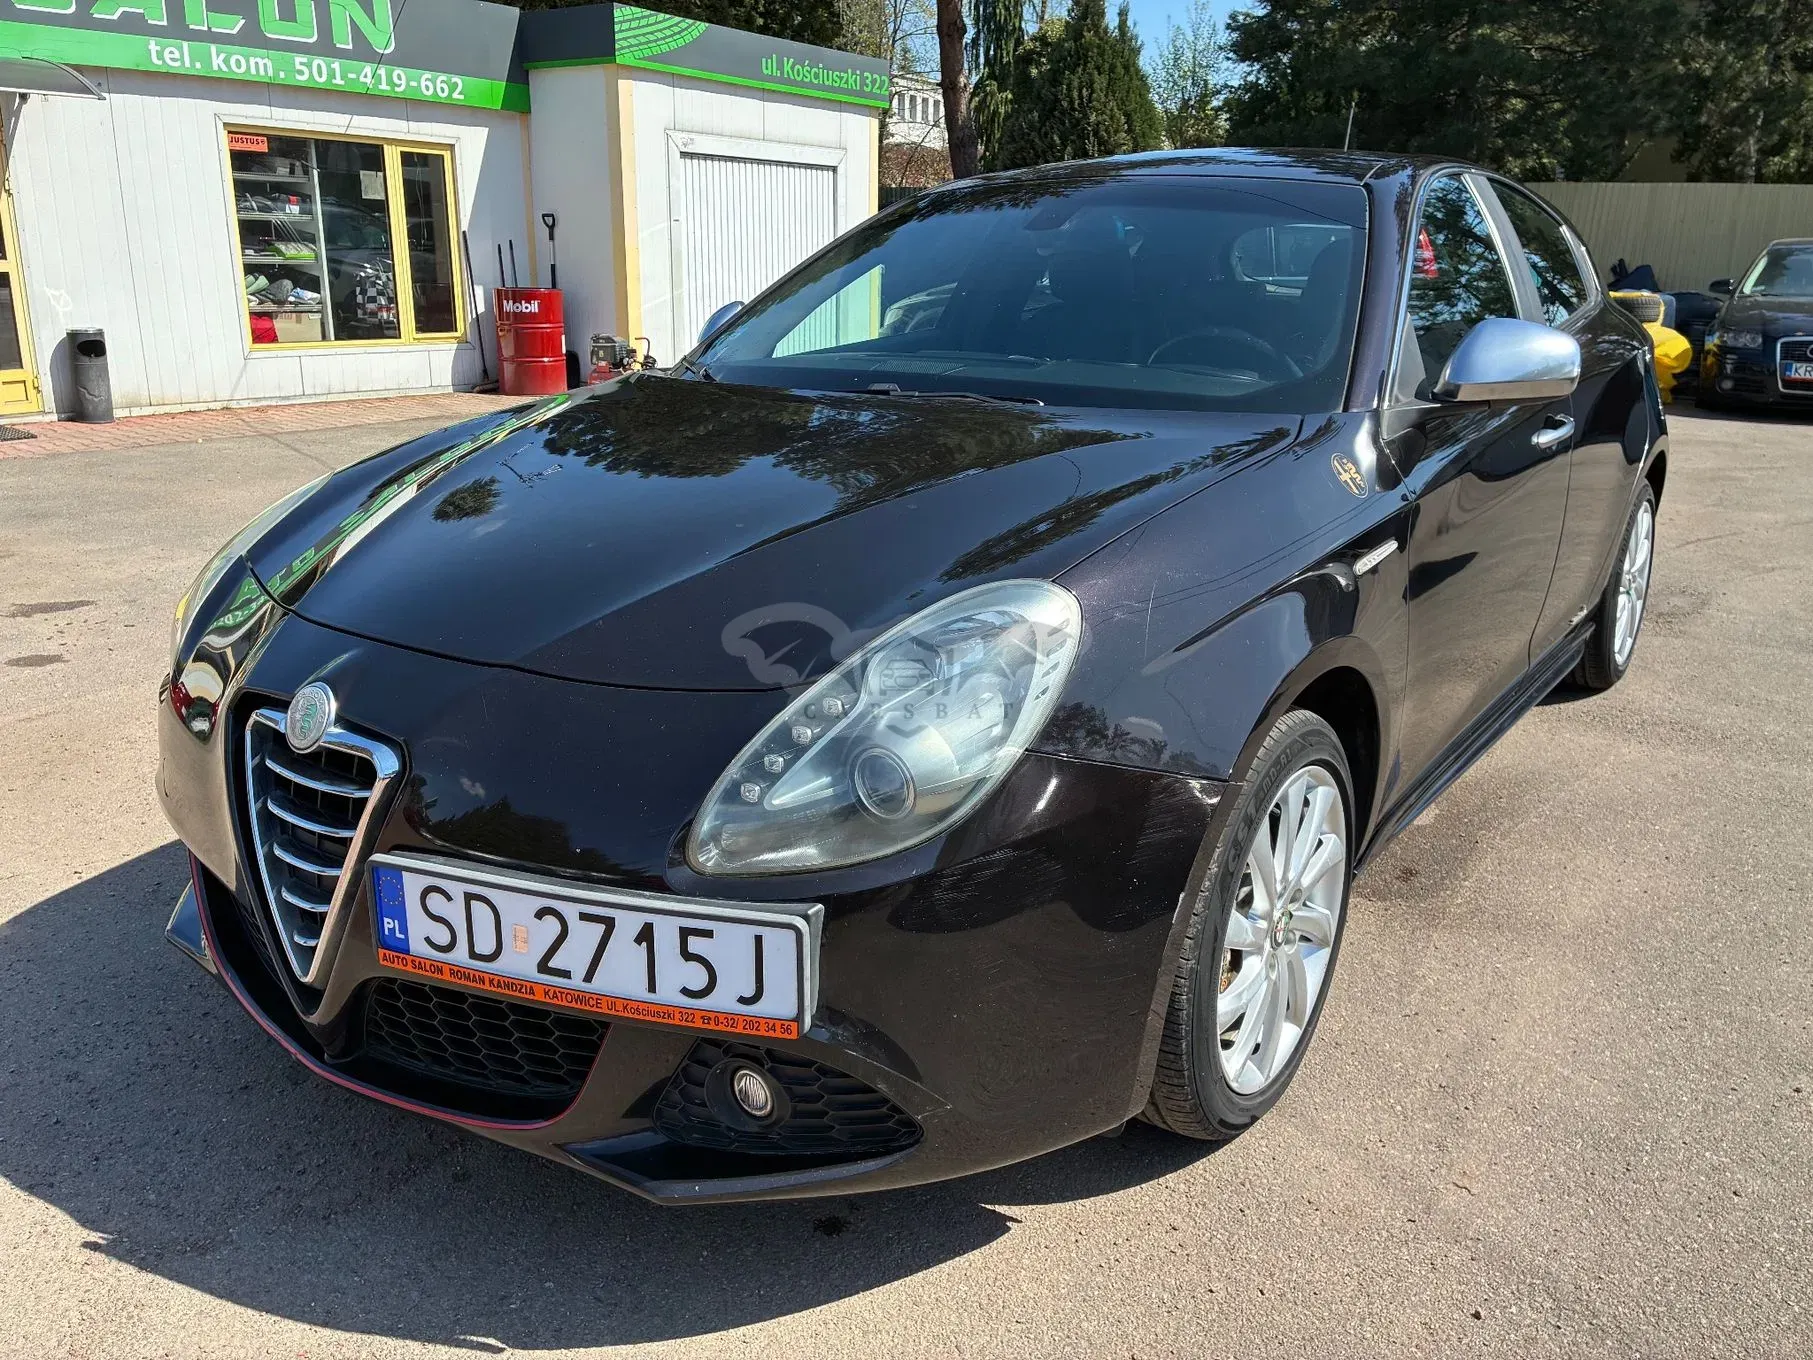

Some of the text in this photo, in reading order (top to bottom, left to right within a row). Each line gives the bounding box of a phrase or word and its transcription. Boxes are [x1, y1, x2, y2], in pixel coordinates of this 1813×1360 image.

[11, 0, 396, 54] LON
[148, 40, 465, 100] tel. kom. 501-419-662
[761, 54, 889, 96] ul. Kościuszki 322
[229, 136, 260, 145] JUSTUS
[503, 300, 539, 313] Mobil
[383, 916, 406, 939] PL
[420, 884, 764, 1006] SD 2715J
[382, 952, 793, 1036] AUTO SALON ROMAN KANDZIA KATOWICE UL.Kościuszki 322 0-32/ 202 34 56
